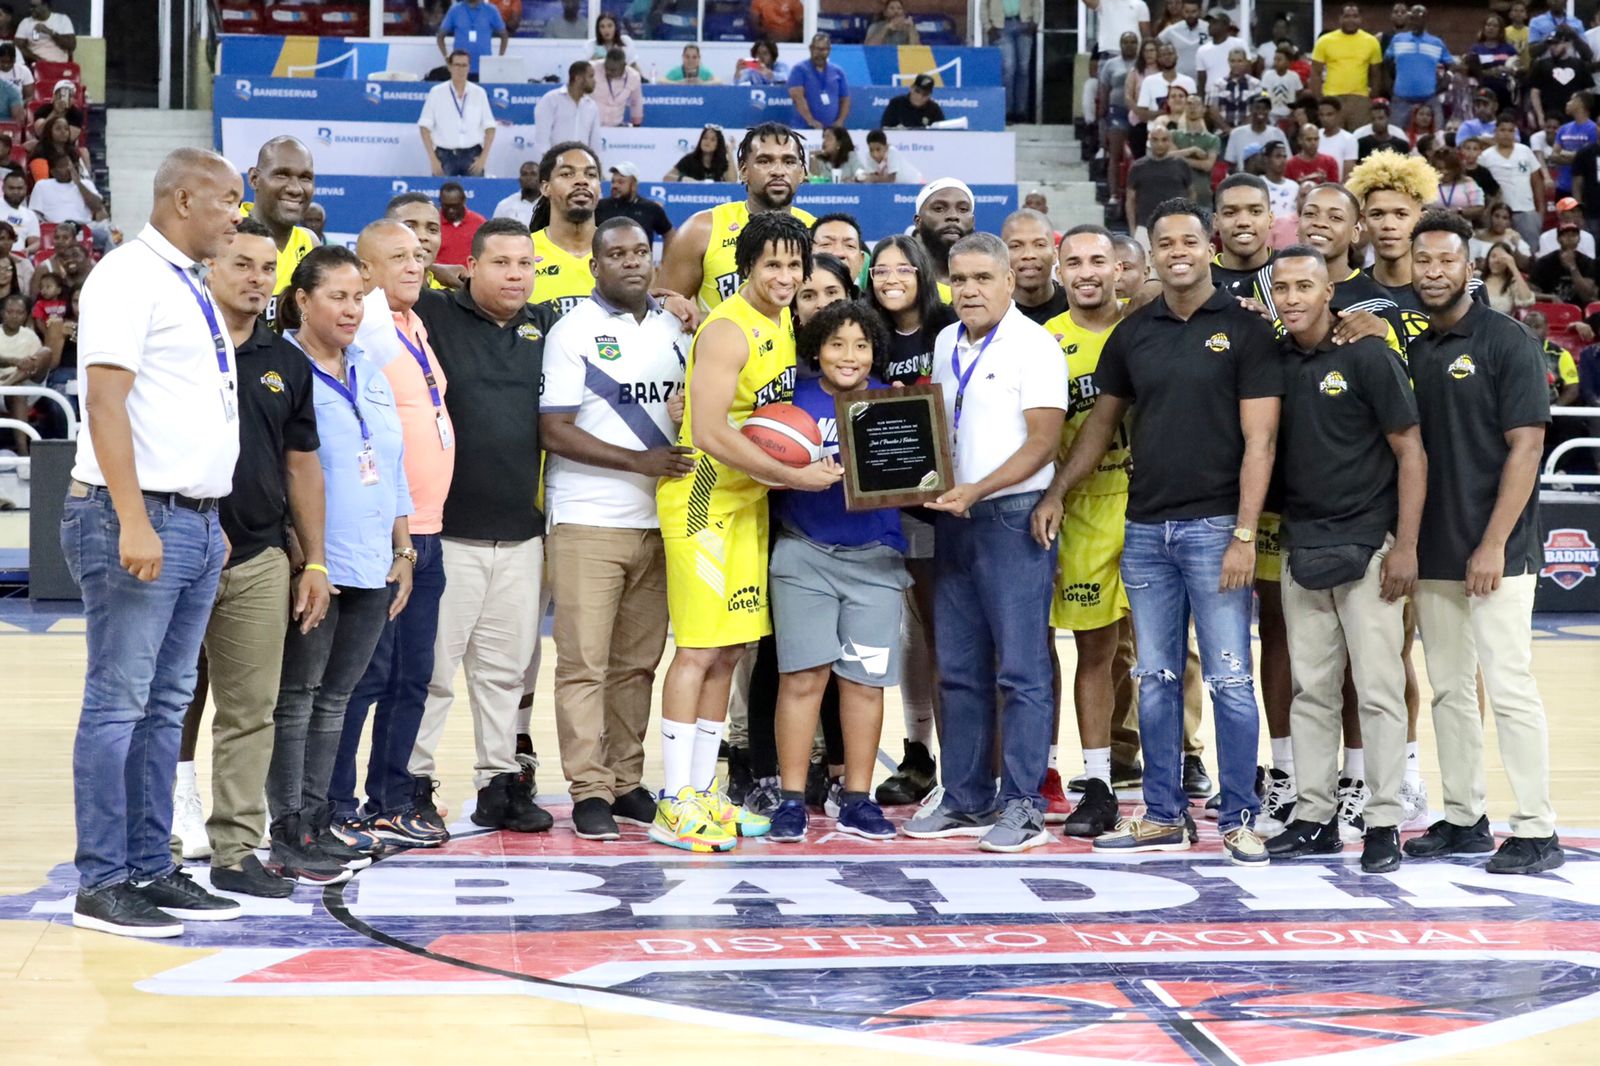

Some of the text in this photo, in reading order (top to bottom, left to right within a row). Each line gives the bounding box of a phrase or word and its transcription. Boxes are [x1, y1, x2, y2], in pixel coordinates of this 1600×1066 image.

[253, 88, 318, 98] BANRESERVAS
[334, 136, 400, 145] BANRESERVAS
[667, 195, 732, 205] BANRESERVAS
[795, 195, 860, 205] BANRESERVAS
[1544, 551, 1600, 563] BADINA
[1062, 589, 1101, 603] Loteka
[728, 595, 760, 612] Lotek
[638, 928, 1521, 955] DISTRITO NACIONAL
